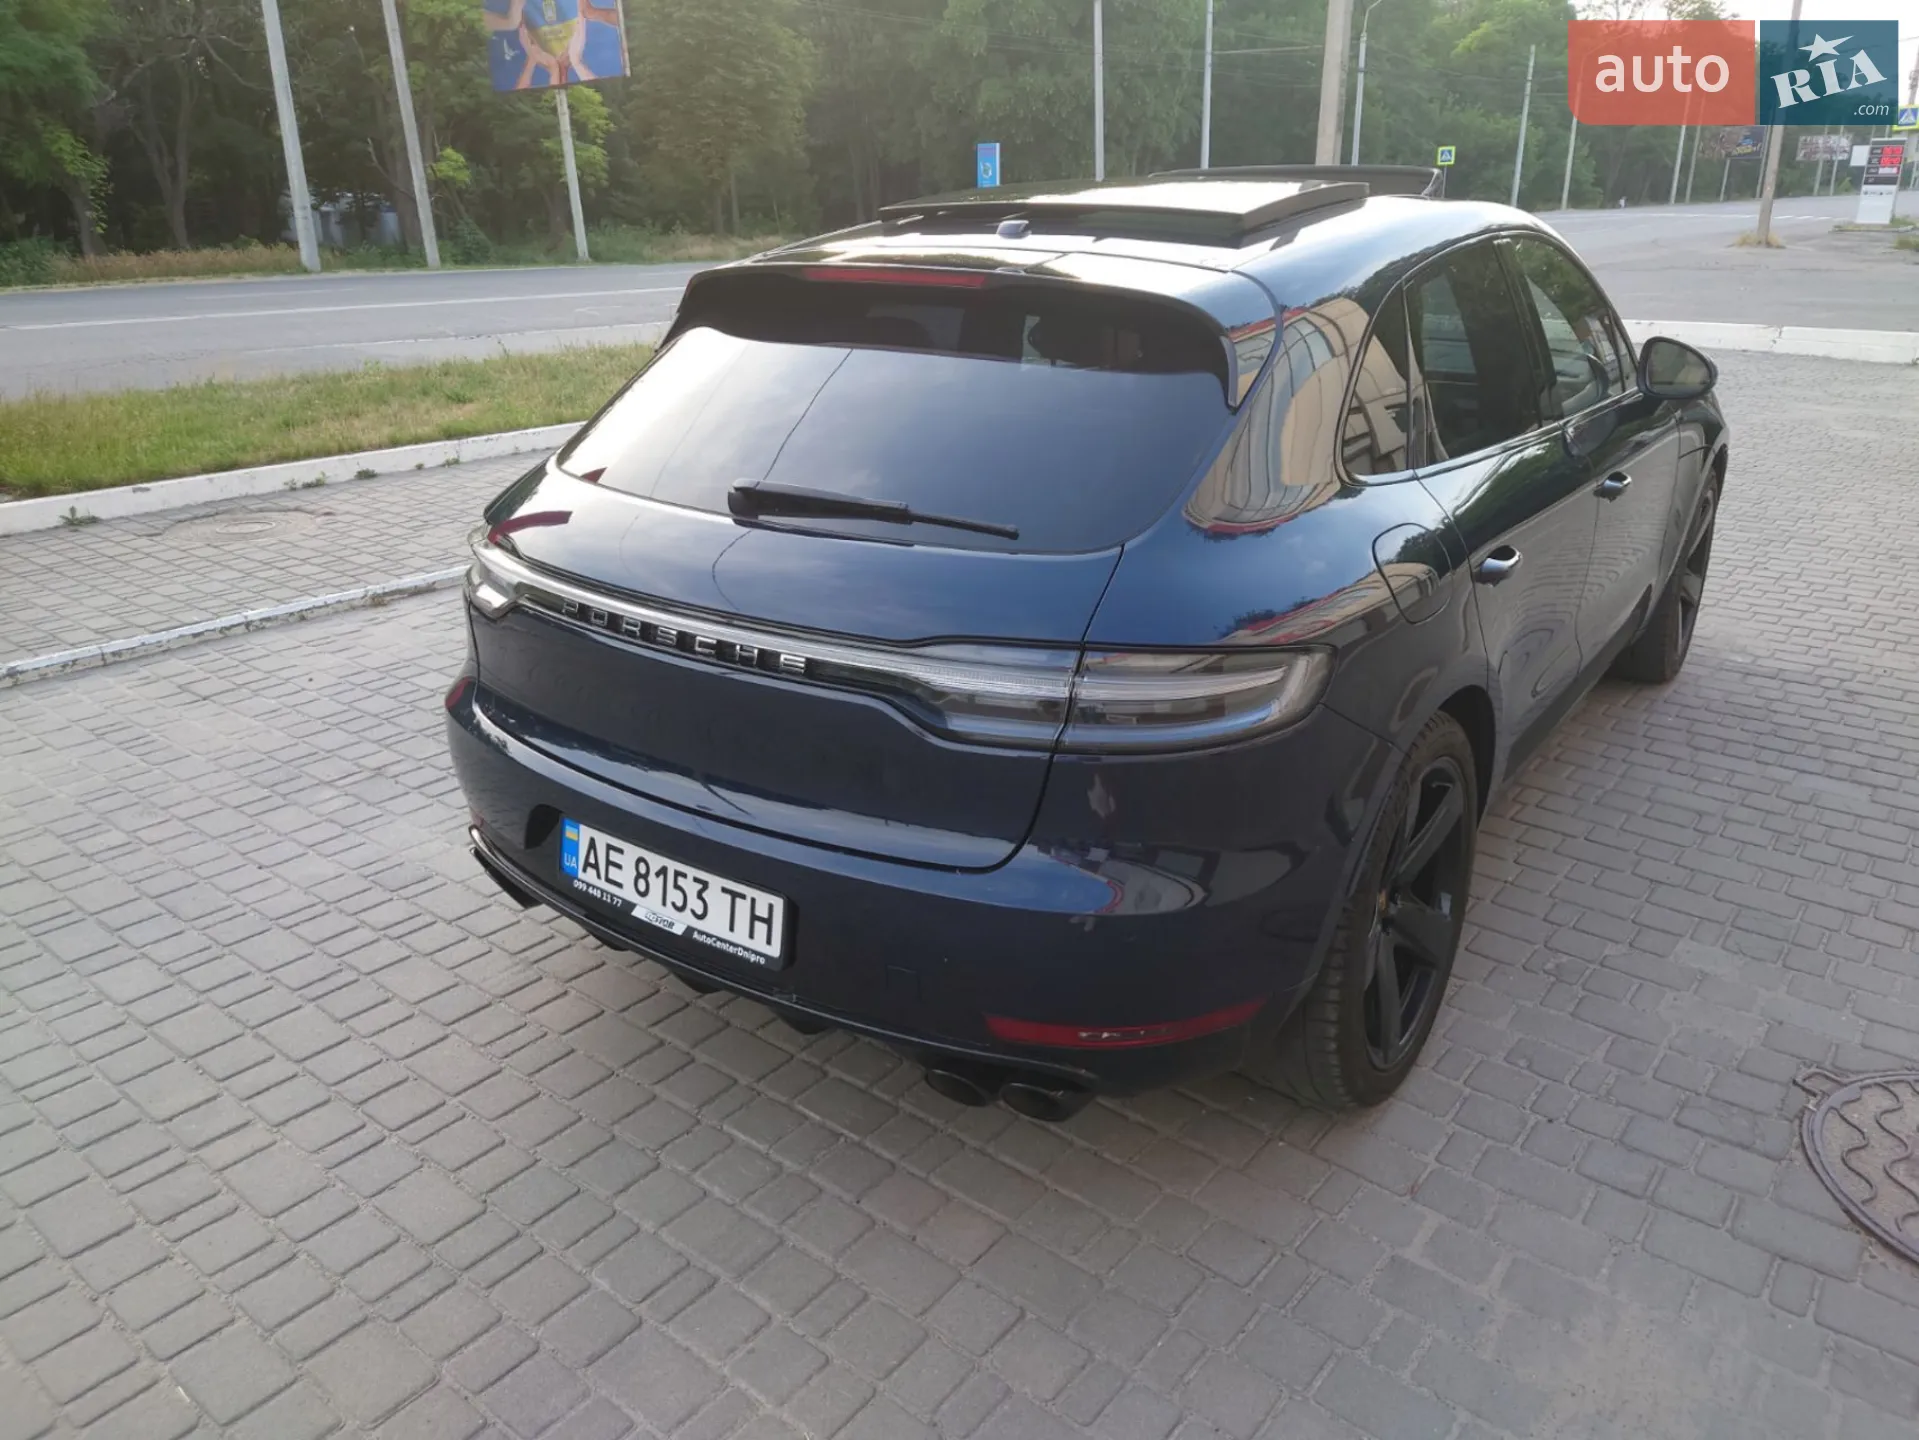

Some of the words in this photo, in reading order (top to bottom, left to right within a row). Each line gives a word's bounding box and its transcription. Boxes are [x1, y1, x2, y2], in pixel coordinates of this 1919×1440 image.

[562, 599, 806, 674] PORSCHE
[564, 852, 578, 869] UA
[581, 836, 625, 890] AE
[633, 855, 710, 921] 8153
[721, 886, 775, 946] TH
